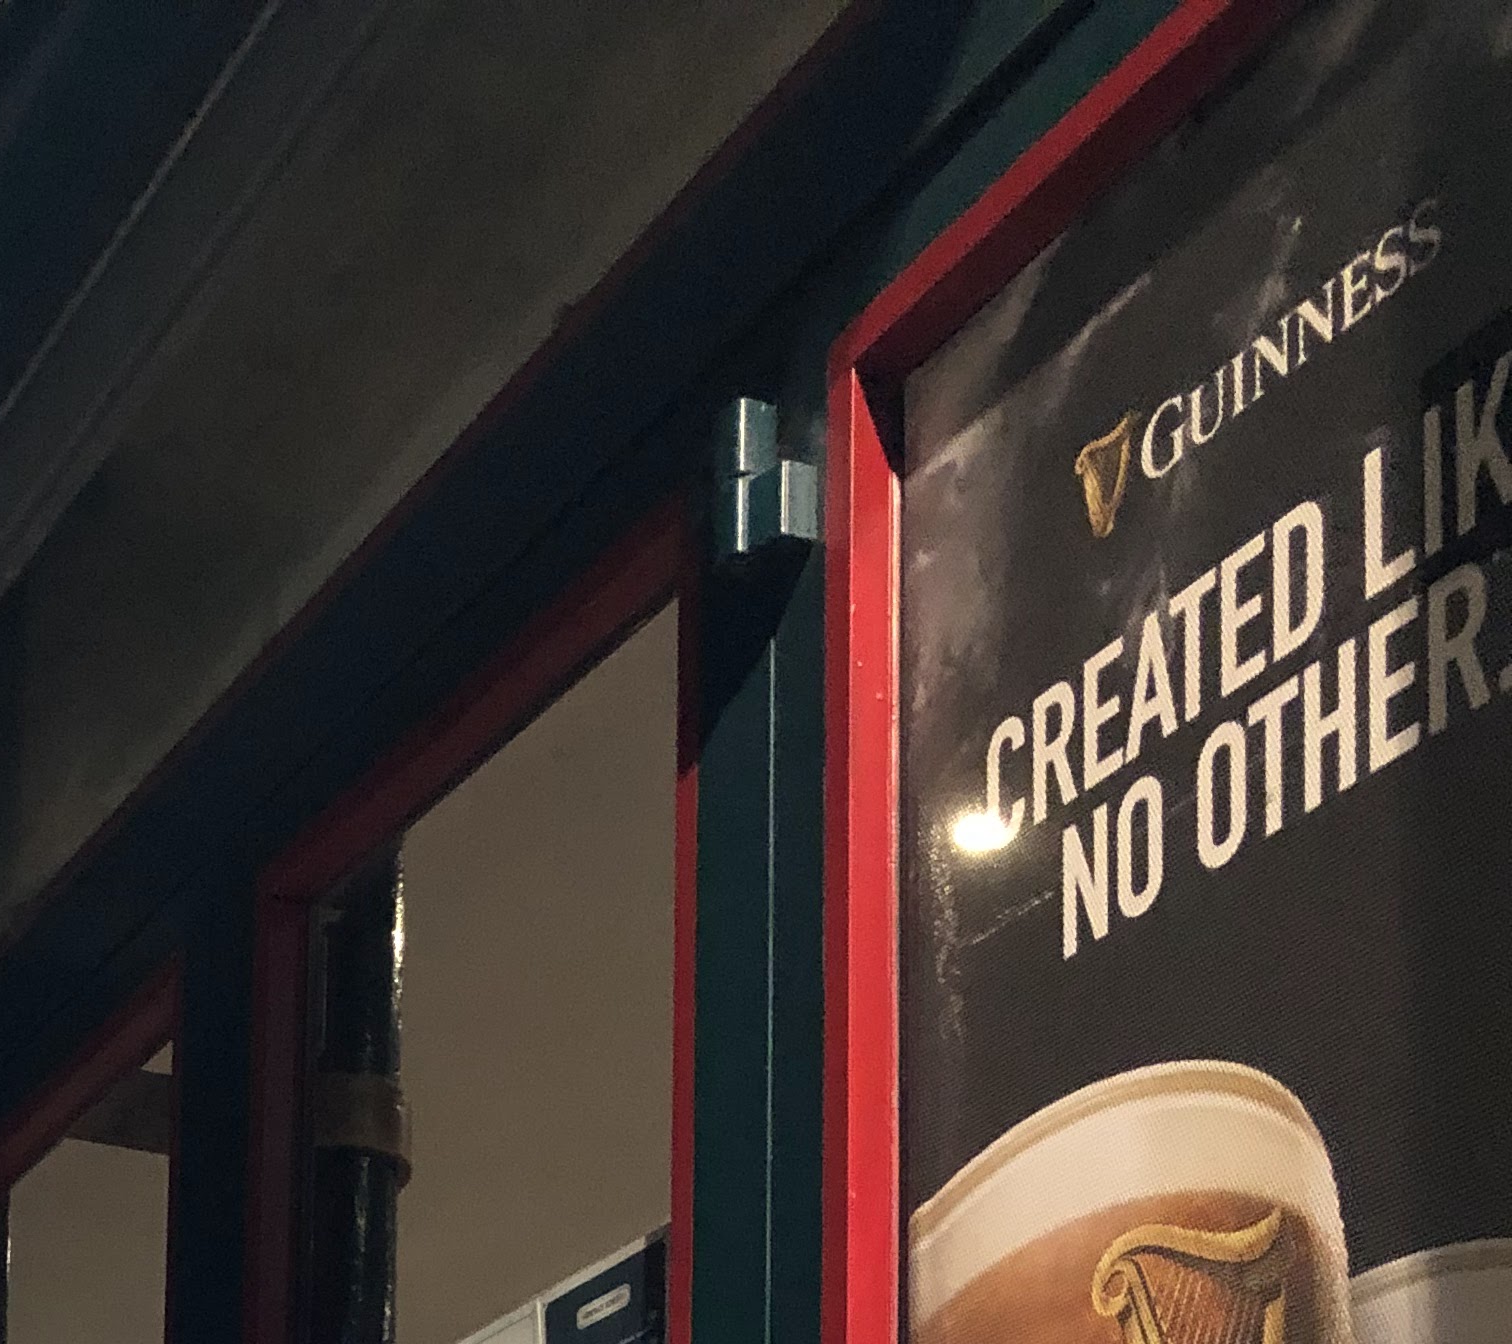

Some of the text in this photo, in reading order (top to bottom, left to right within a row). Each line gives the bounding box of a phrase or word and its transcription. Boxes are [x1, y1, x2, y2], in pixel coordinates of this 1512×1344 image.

[1141, 199, 1441, 478] GUINNESS
[986, 501, 1326, 850] CREATED
[1062, 776, 1163, 960] NO
